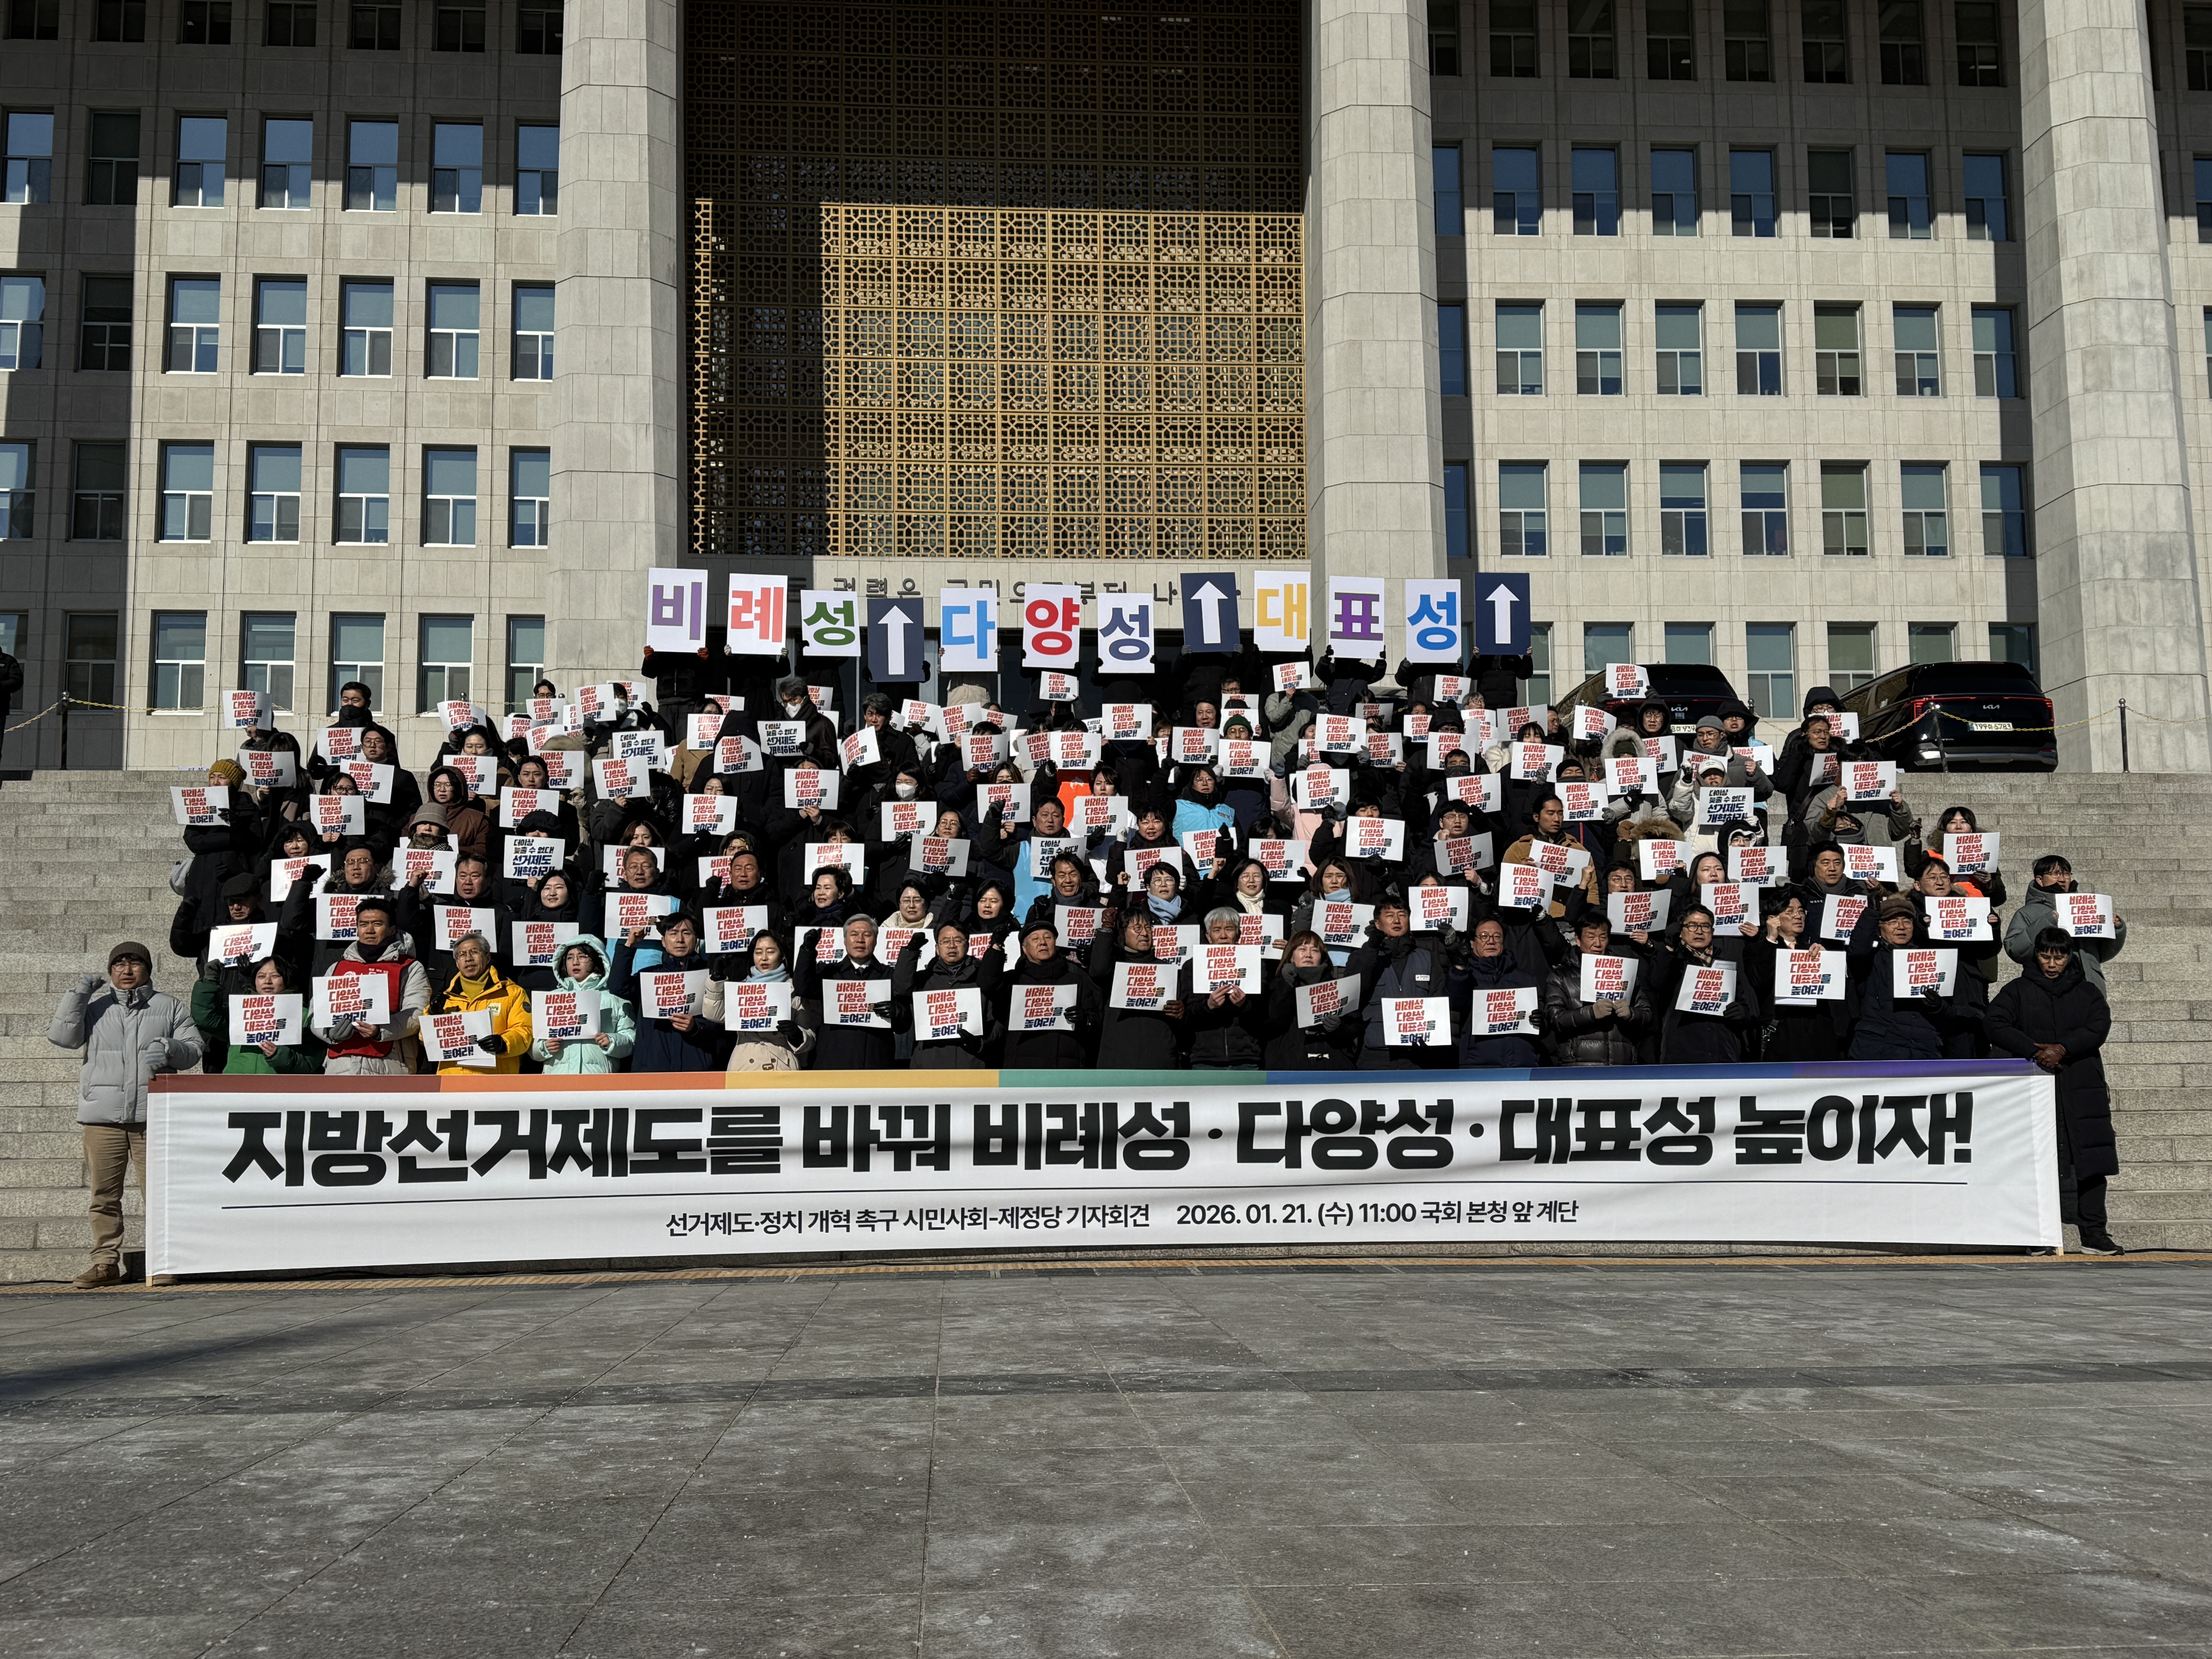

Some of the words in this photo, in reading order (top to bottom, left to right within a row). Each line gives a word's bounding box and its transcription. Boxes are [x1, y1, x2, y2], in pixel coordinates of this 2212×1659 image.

[652, 582, 702, 640] 비
[731, 587, 783, 642] 례
[1257, 584, 1307, 639] 대
[1331, 592, 1383, 640] 표
[803, 600, 855, 645] 성
[1407, 592, 1457, 649] 성
[942, 600, 995, 659] 다
[1026, 598, 1080, 655] 양
[1099, 604, 1149, 660] 성
[1707, 803, 1745, 813] 선거제도
[513, 855, 552, 866] 선거제도
[1513, 867, 1538, 877] 비례성
[1513, 877, 1539, 886] 다양성
[1513, 887, 1546, 898] 대표성을
[1714, 884, 1739, 895] 비례성
[1715, 895, 1740, 905] 다양성
[1938, 898, 1965, 908] 비례성
[2070, 895, 2095, 905] 비례성
[716, 908, 744, 919] 비례성
[1326, 904, 1353, 913] 비례성
[1715, 903, 1749, 915] 대표성을
[1940, 909, 1966, 918] 다양성
[2071, 905, 2097, 915] 다양성
[718, 918, 744, 930] 다양성
[1326, 914, 1352, 923] 다양성
[1715, 914, 1744, 926] 높여라!
[1941, 919, 1977, 928] 대표성을
[2073, 915, 2106, 924] 대표성을
[719, 927, 754, 940] 대표성을
[1324, 924, 1360, 933] 대표성을
[1943, 929, 1972, 938] 높여라!
[2075, 925, 2102, 935] 높여라!
[1324, 934, 1353, 943] 높여라!
[1128, 965, 1157, 975] 비례성
[1697, 970, 1723, 980] 비례성
[654, 973, 684, 985] 비례성
[1128, 977, 1156, 986] 다양성
[656, 984, 685, 996] 다양성
[738, 984, 766, 995] 비례성
[1695, 981, 1723, 991] 다양성
[1025, 987, 1054, 997] 비례성
[1126, 988, 1165, 997] 대표성을
[1487, 990, 1515, 1002] 비례성
[1692, 991, 1729, 1002] 대표성을
[243, 996, 274, 1008] 비례성
[546, 993, 575, 1005] 비례성
[657, 993, 696, 1006] 대표성을
[738, 996, 767, 1006] 다양성
[1025, 997, 1054, 1008] 다양성
[1125, 998, 1158, 1007] 높여라!
[546, 1004, 576, 1015] 다양성
[739, 1006, 778, 1017] 대표성을
[1487, 1001, 1516, 1012] 다양성
[1690, 1001, 1721, 1012] 높여라!
[244, 1008, 275, 1020] 다양성
[1024, 1007, 1063, 1018] 대표성을
[1487, 1011, 1526, 1022] 대표성을
[245, 1018, 287, 1032] 대표성을
[434, 1015, 462, 1027] 비례성
[547, 1014, 587, 1027] 대표성을
[740, 1018, 771, 1029] 높여라!
[1024, 1017, 1056, 1028] 높여라!
[437, 1026, 465, 1038] 다양성
[549, 1026, 581, 1039] 높여라!
[1488, 1021, 1520, 1033] 높여라!
[440, 1035, 476, 1048] 대표성을
[443, 1046, 474, 1059] 높여라!
[222, 1106, 783, 1186] 지방선거제도를
[803, 1104, 950, 1172] 바꿔
[1733, 1092, 1973, 1164] 높이자!
[808, 1210, 850, 1233] 개혁
[856, 1209, 899, 1231] 촉구
[1066, 1204, 1149, 1228] 기자회견
[1318, 1202, 1353, 1226] (수)
[1359, 1203, 1416, 1223] 11:00
[1421, 1201, 1461, 1223] 국회
[1466, 1201, 1507, 1223] 본청
[1512, 1202, 1534, 1223] 앞
[1536, 1200, 1579, 1223] 계단
